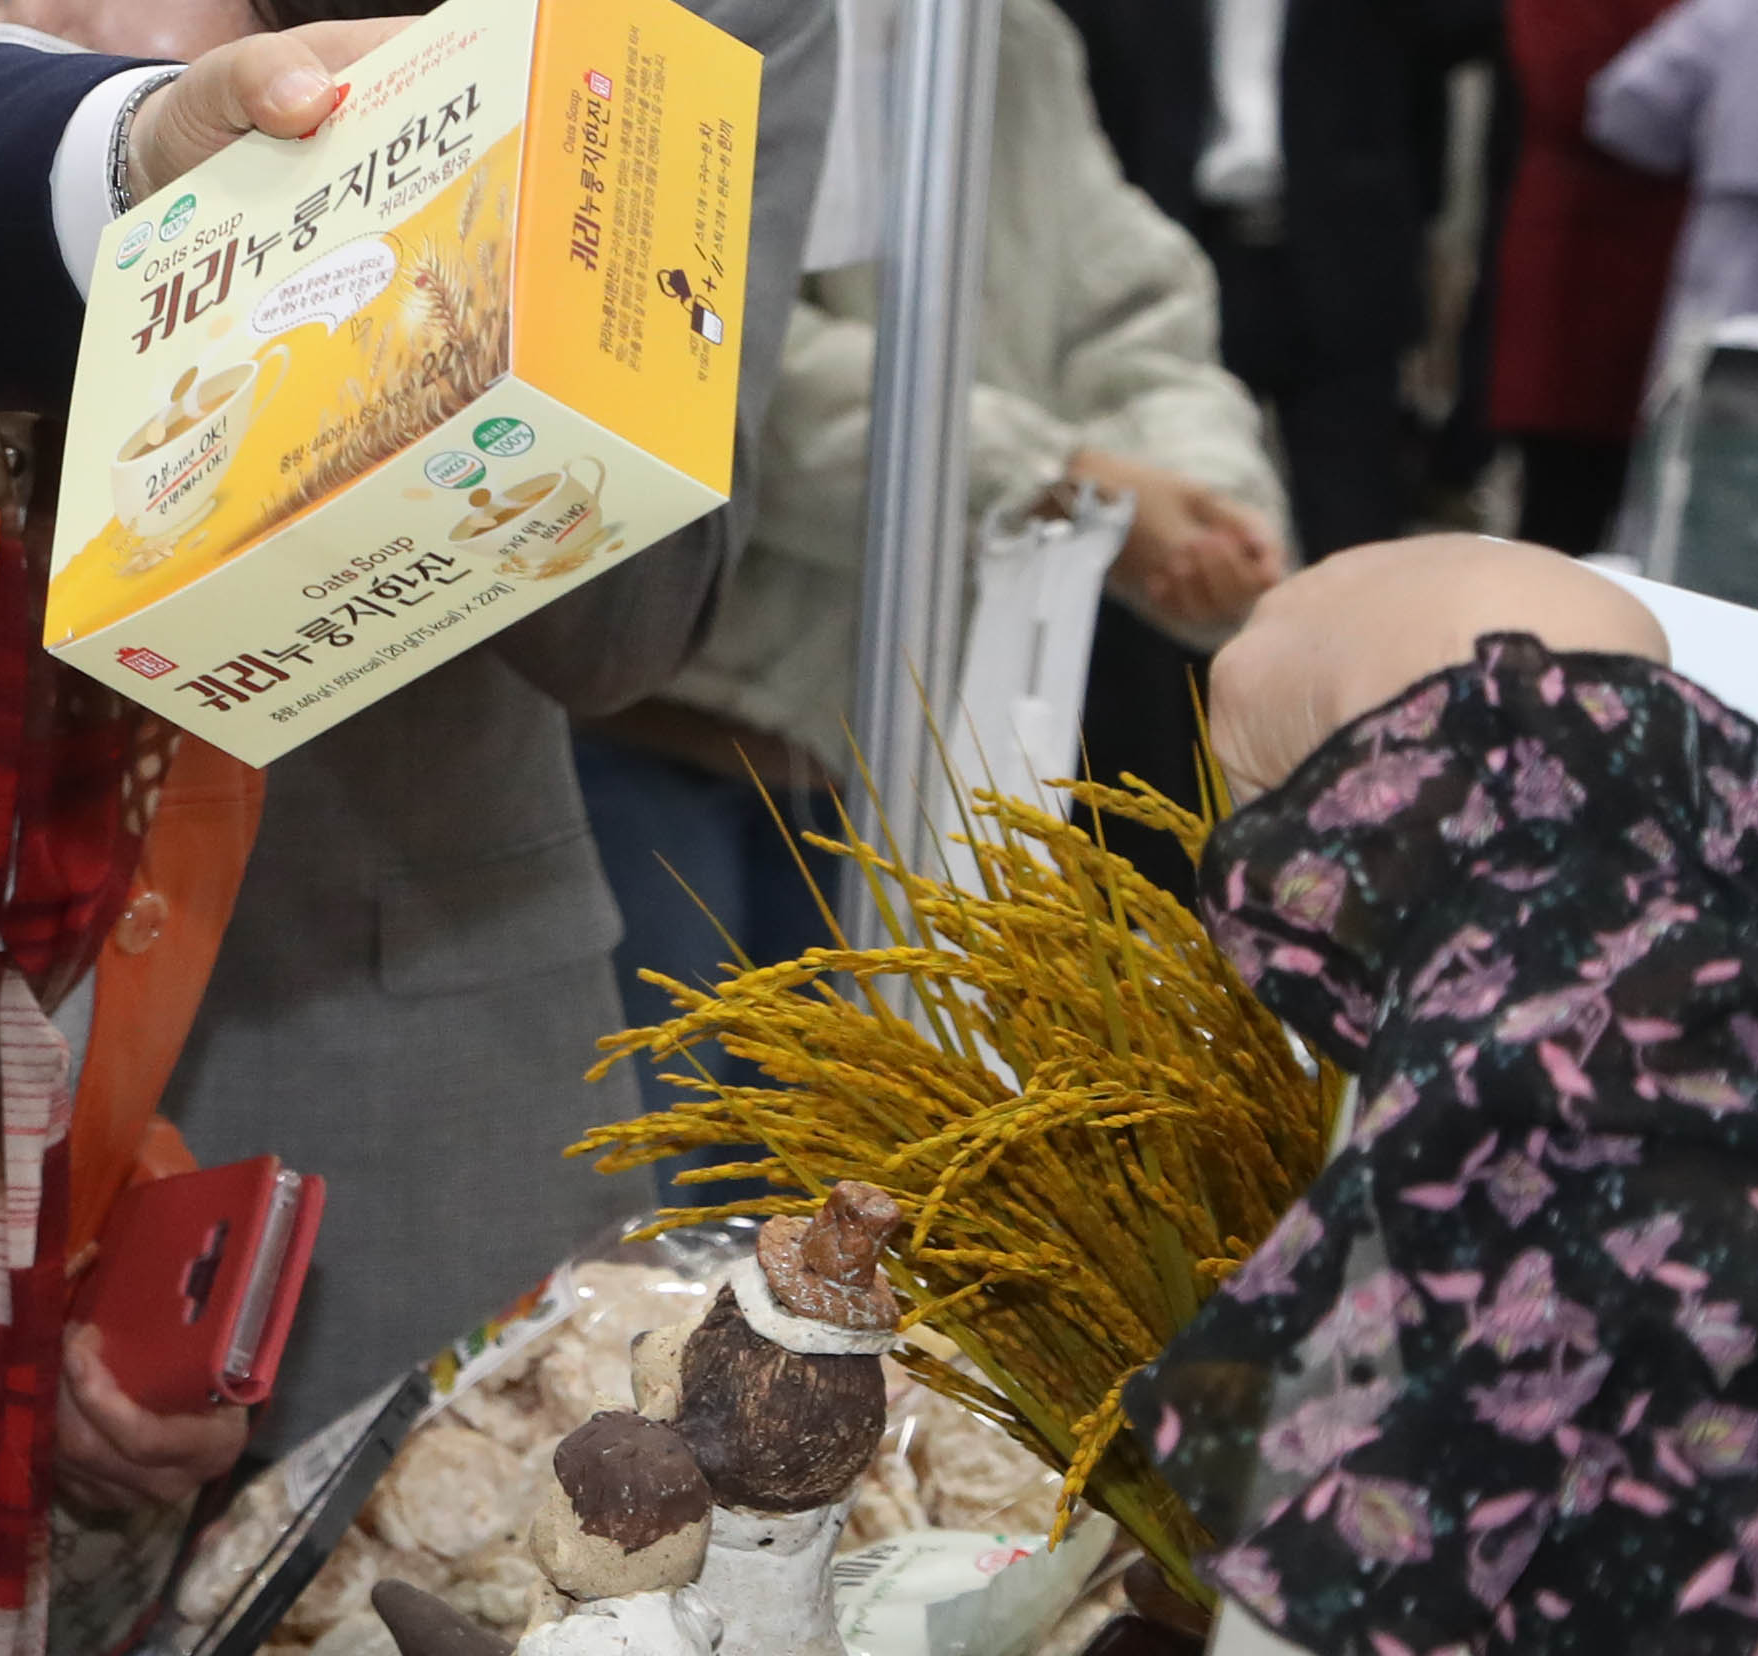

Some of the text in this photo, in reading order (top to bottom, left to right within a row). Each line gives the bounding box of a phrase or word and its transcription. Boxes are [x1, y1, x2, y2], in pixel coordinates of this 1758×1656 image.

[562, 88, 582, 154] Oats Soup
[131, 83, 480, 354] 귀리누룽지한잔
[569, 98, 610, 271] 귀리누룽지한잔
[142, 211, 243, 283] Oats Soup
[490, 430, 535, 454] 100%
[301, 536, 414, 599] Oats Soup
[174, 550, 471, 711] 귀리누룽지한잔
